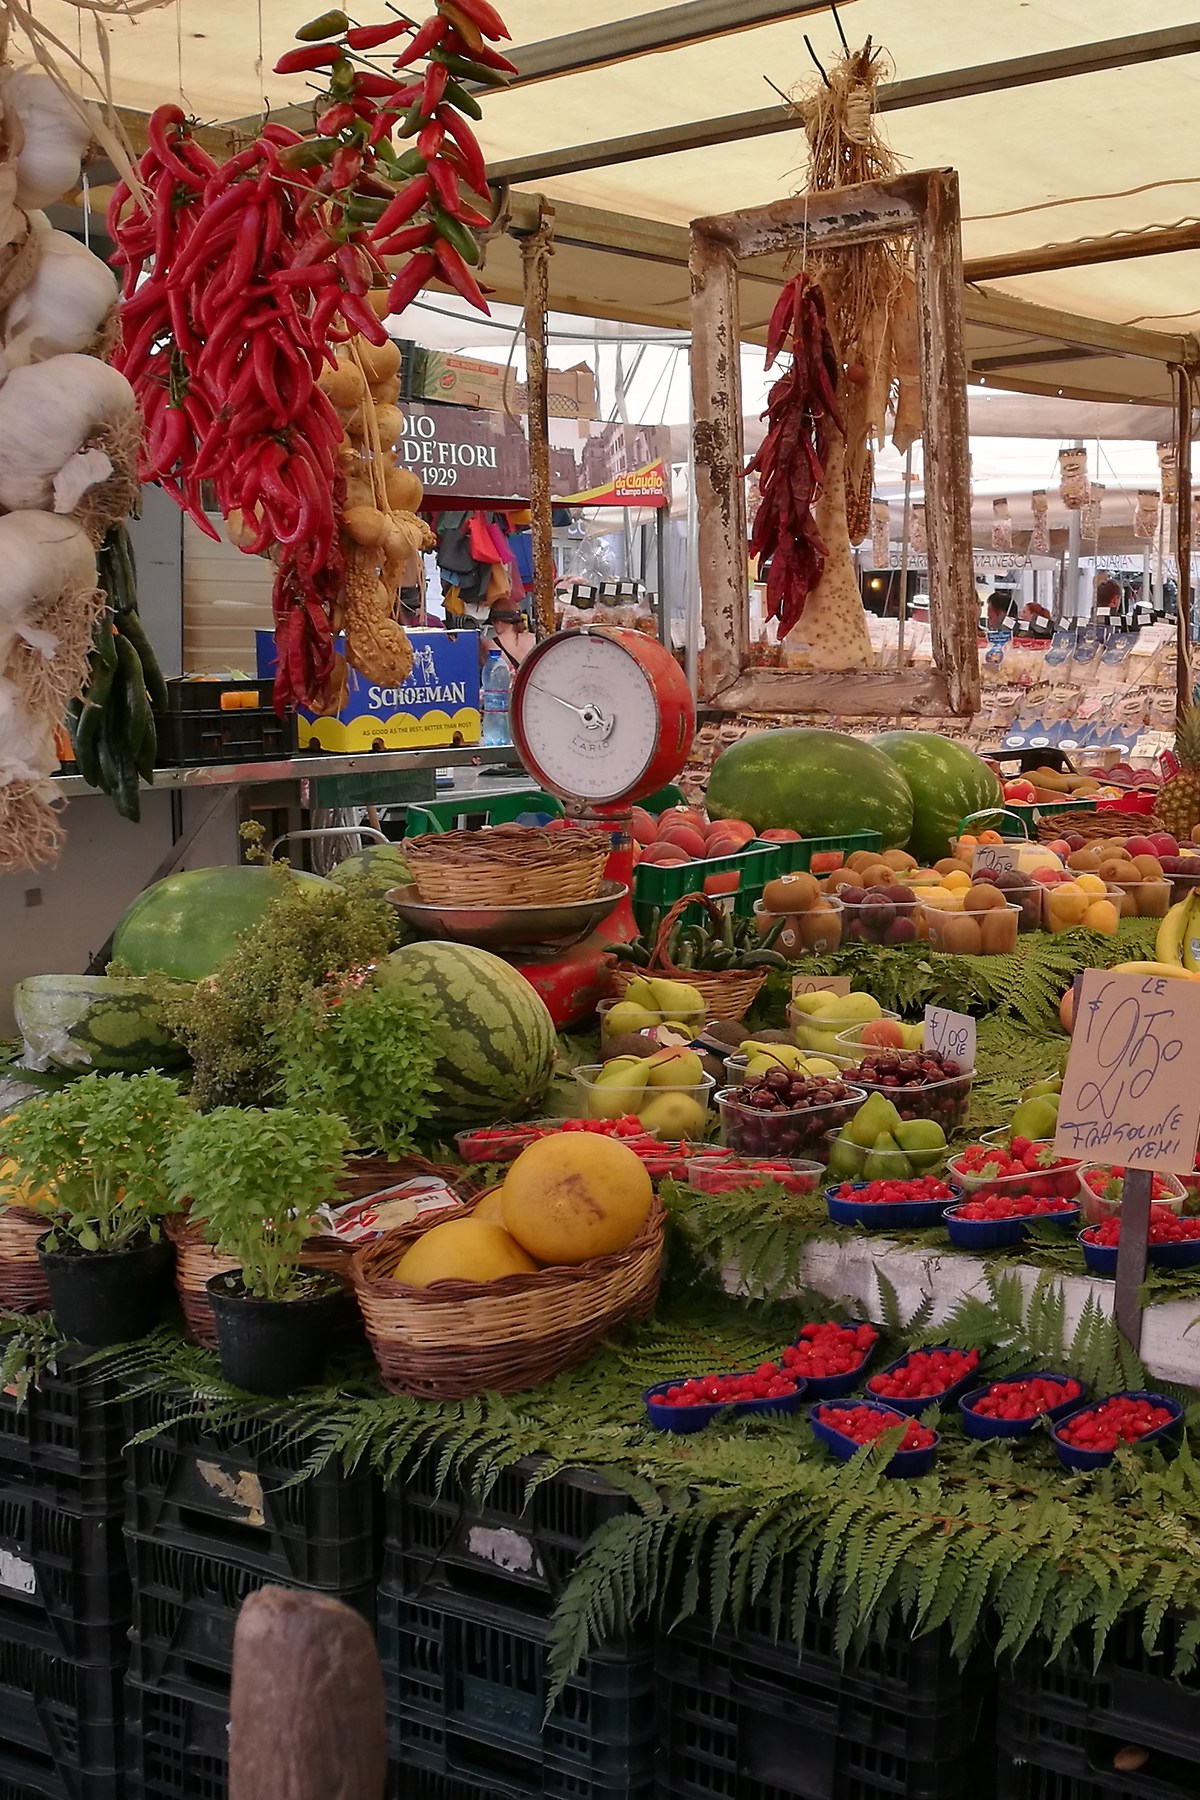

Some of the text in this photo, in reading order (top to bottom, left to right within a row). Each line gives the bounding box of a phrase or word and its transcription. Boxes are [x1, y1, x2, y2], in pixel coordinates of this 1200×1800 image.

[402, 439, 498, 468] DE'FIORI
[420, 466, 458, 486] 1929
[615, 473, 662, 488] da Claudio
[368, 681, 466, 710] SCHOEMAN
[372, 728, 388, 736] GOOD
[424, 723, 444, 732] BETTER
[572, 737, 610, 752] LARIO
[1060, 1104, 1184, 1149] FRAGOLINE
[1128, 1139, 1181, 1162] NEMI
